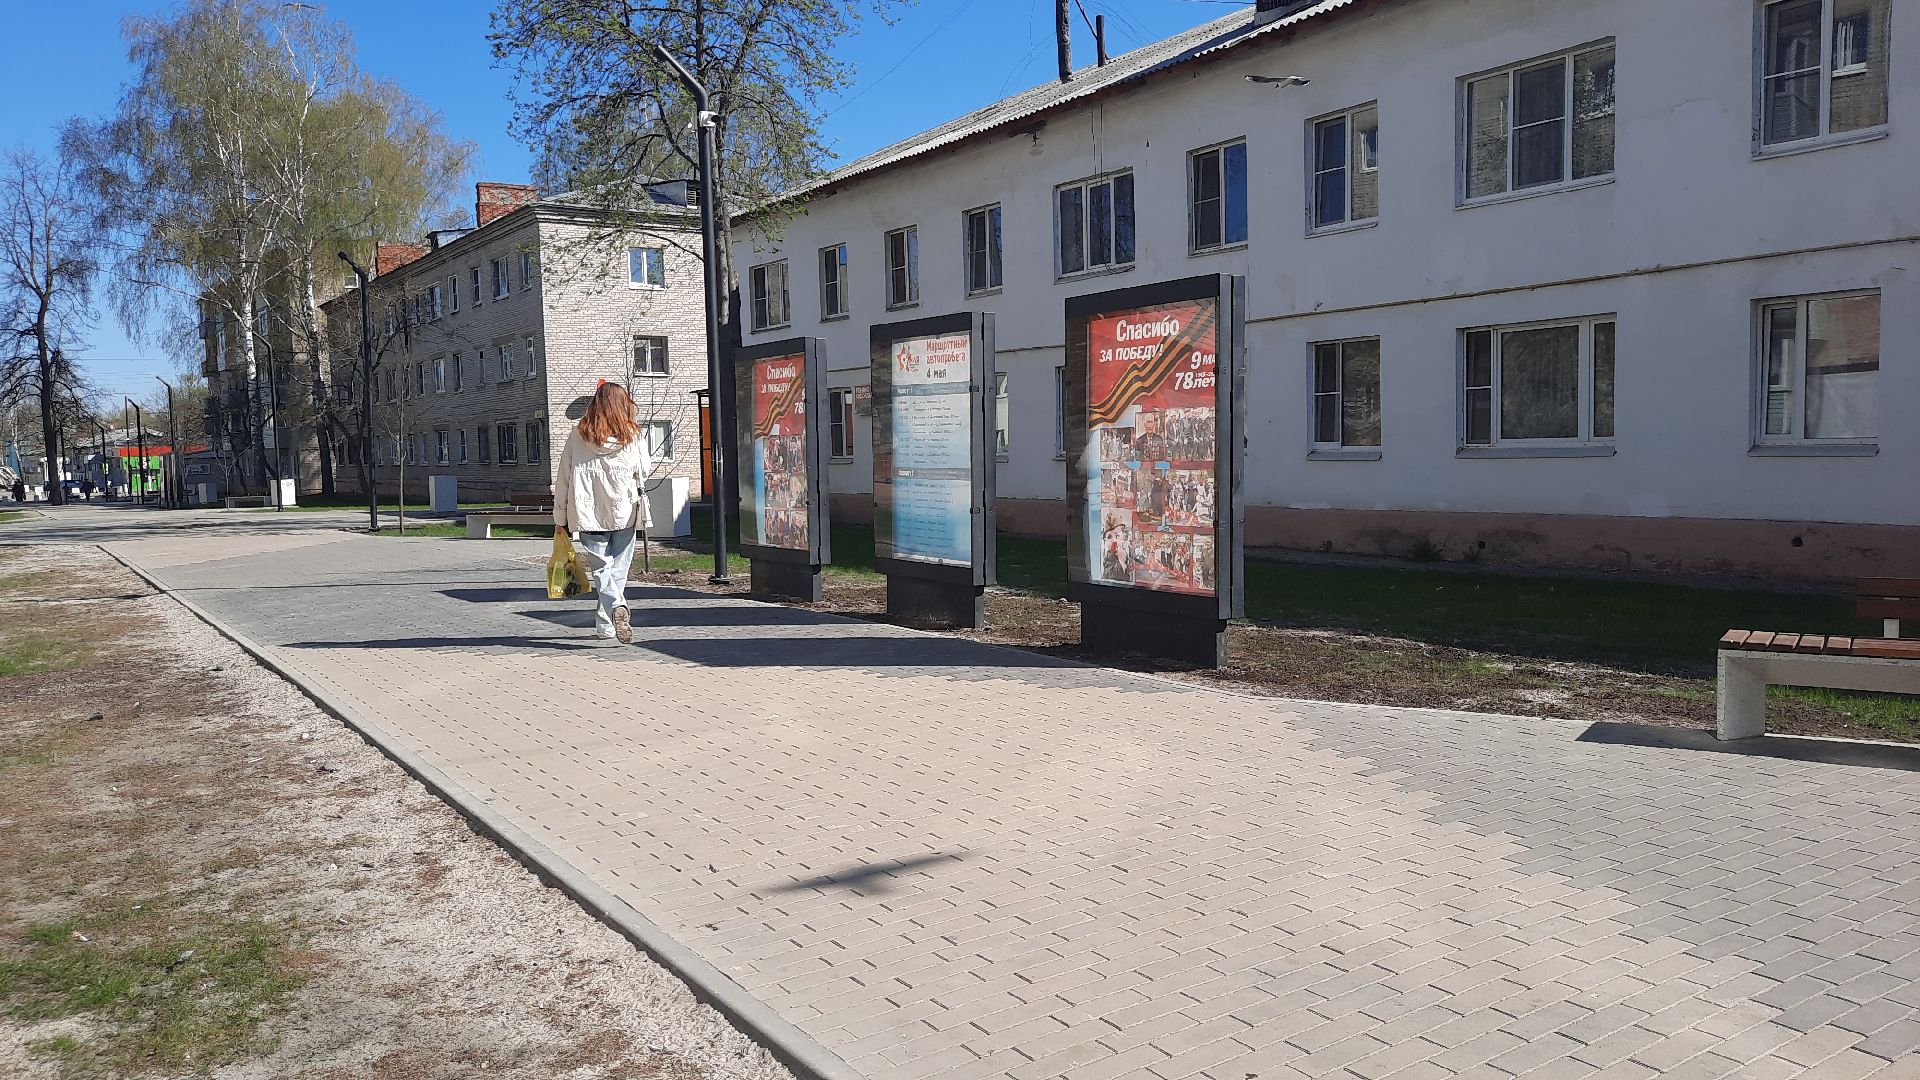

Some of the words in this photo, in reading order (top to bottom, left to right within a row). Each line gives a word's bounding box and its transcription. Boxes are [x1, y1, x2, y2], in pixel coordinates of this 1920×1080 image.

[1116, 314, 1180, 342] Спасибо
[926, 336, 968, 353] Маршрутный
[1099, 348, 1113, 363] ЗА
[1115, 343, 1165, 361] ПОБЕДУ!
[926, 351, 966, 365] автопробега
[1190, 350, 1201, 370] 9
[767, 362, 796, 380] Спасибо
[926, 368, 931, 379] 4
[933, 369, 947, 379] мая
[1174, 371, 1193, 391] 78
